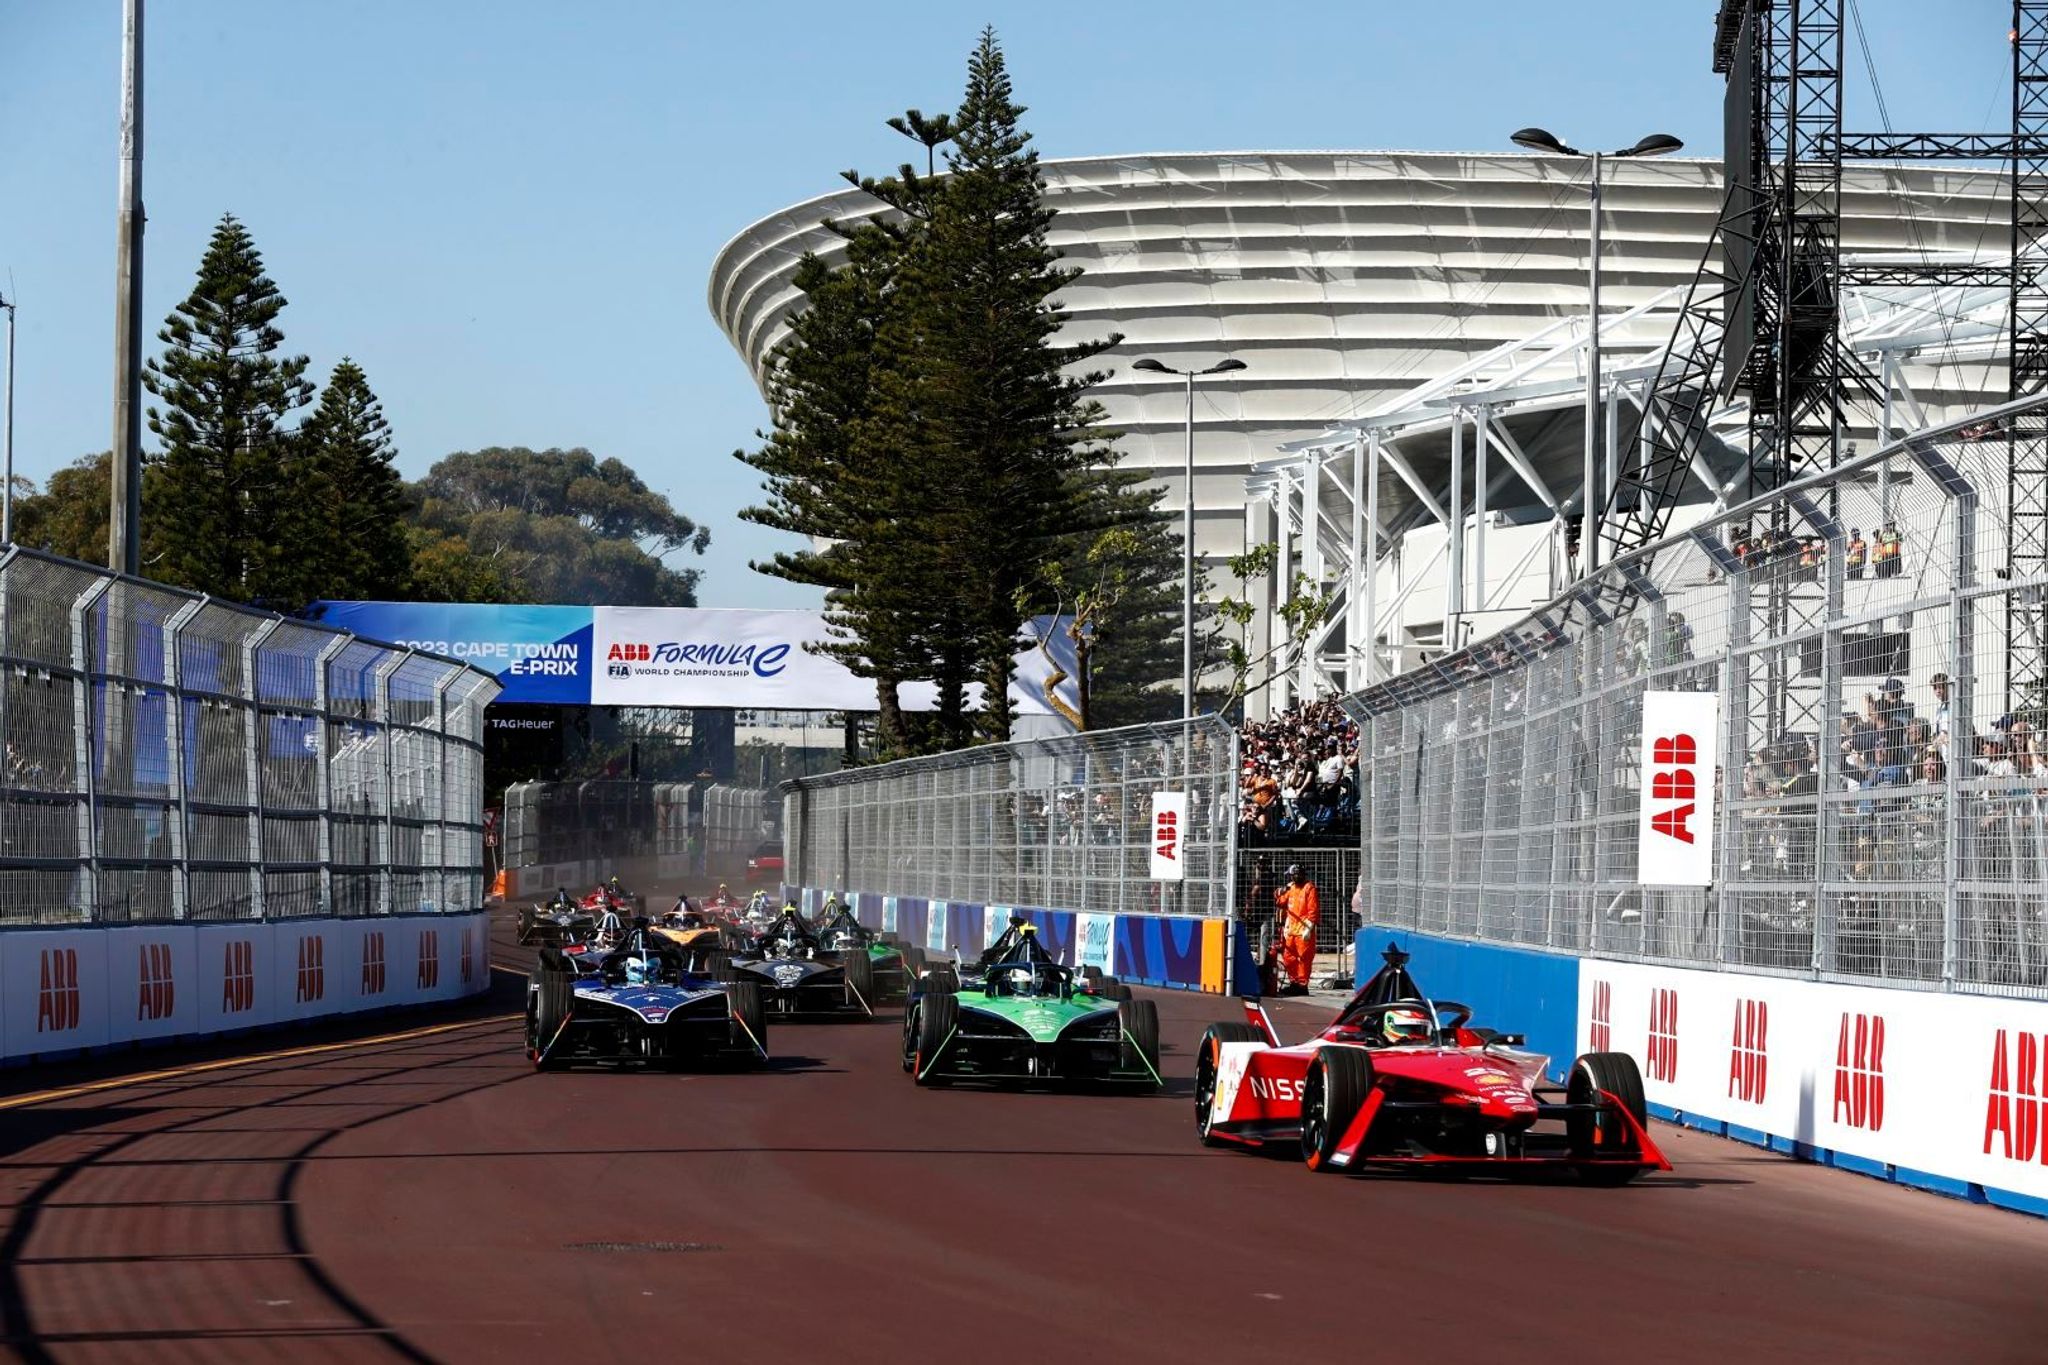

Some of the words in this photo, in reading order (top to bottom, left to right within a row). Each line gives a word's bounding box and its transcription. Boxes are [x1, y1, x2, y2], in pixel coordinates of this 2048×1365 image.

[394, 640, 449, 656] 023
[453, 643, 509, 658] CAPE
[511, 643, 578, 659] TOWN
[510, 660, 578, 676] E-PRIX
[607, 644, 650, 661] ABB
[652, 642, 757, 666] FORMULA
[635, 668, 670, 676] WORLD
[673, 668, 750, 677] CHAMPIONSHIP
[1651, 733, 1697, 846] ABB
[1156, 810, 1178, 862] ABB
[38, 947, 80, 1033] ABB
[138, 943, 175, 1022] ABB
[222, 940, 254, 1014] ABB
[297, 935, 325, 1003] ABB
[361, 931, 385, 996] ABB
[417, 929, 439, 990] ABB
[1646, 988, 1678, 1084] ABB
[1728, 997, 1768, 1105] ABB
[1833, 1012, 1885, 1132] ABB
[1983, 1029, 2048, 1166] AB
